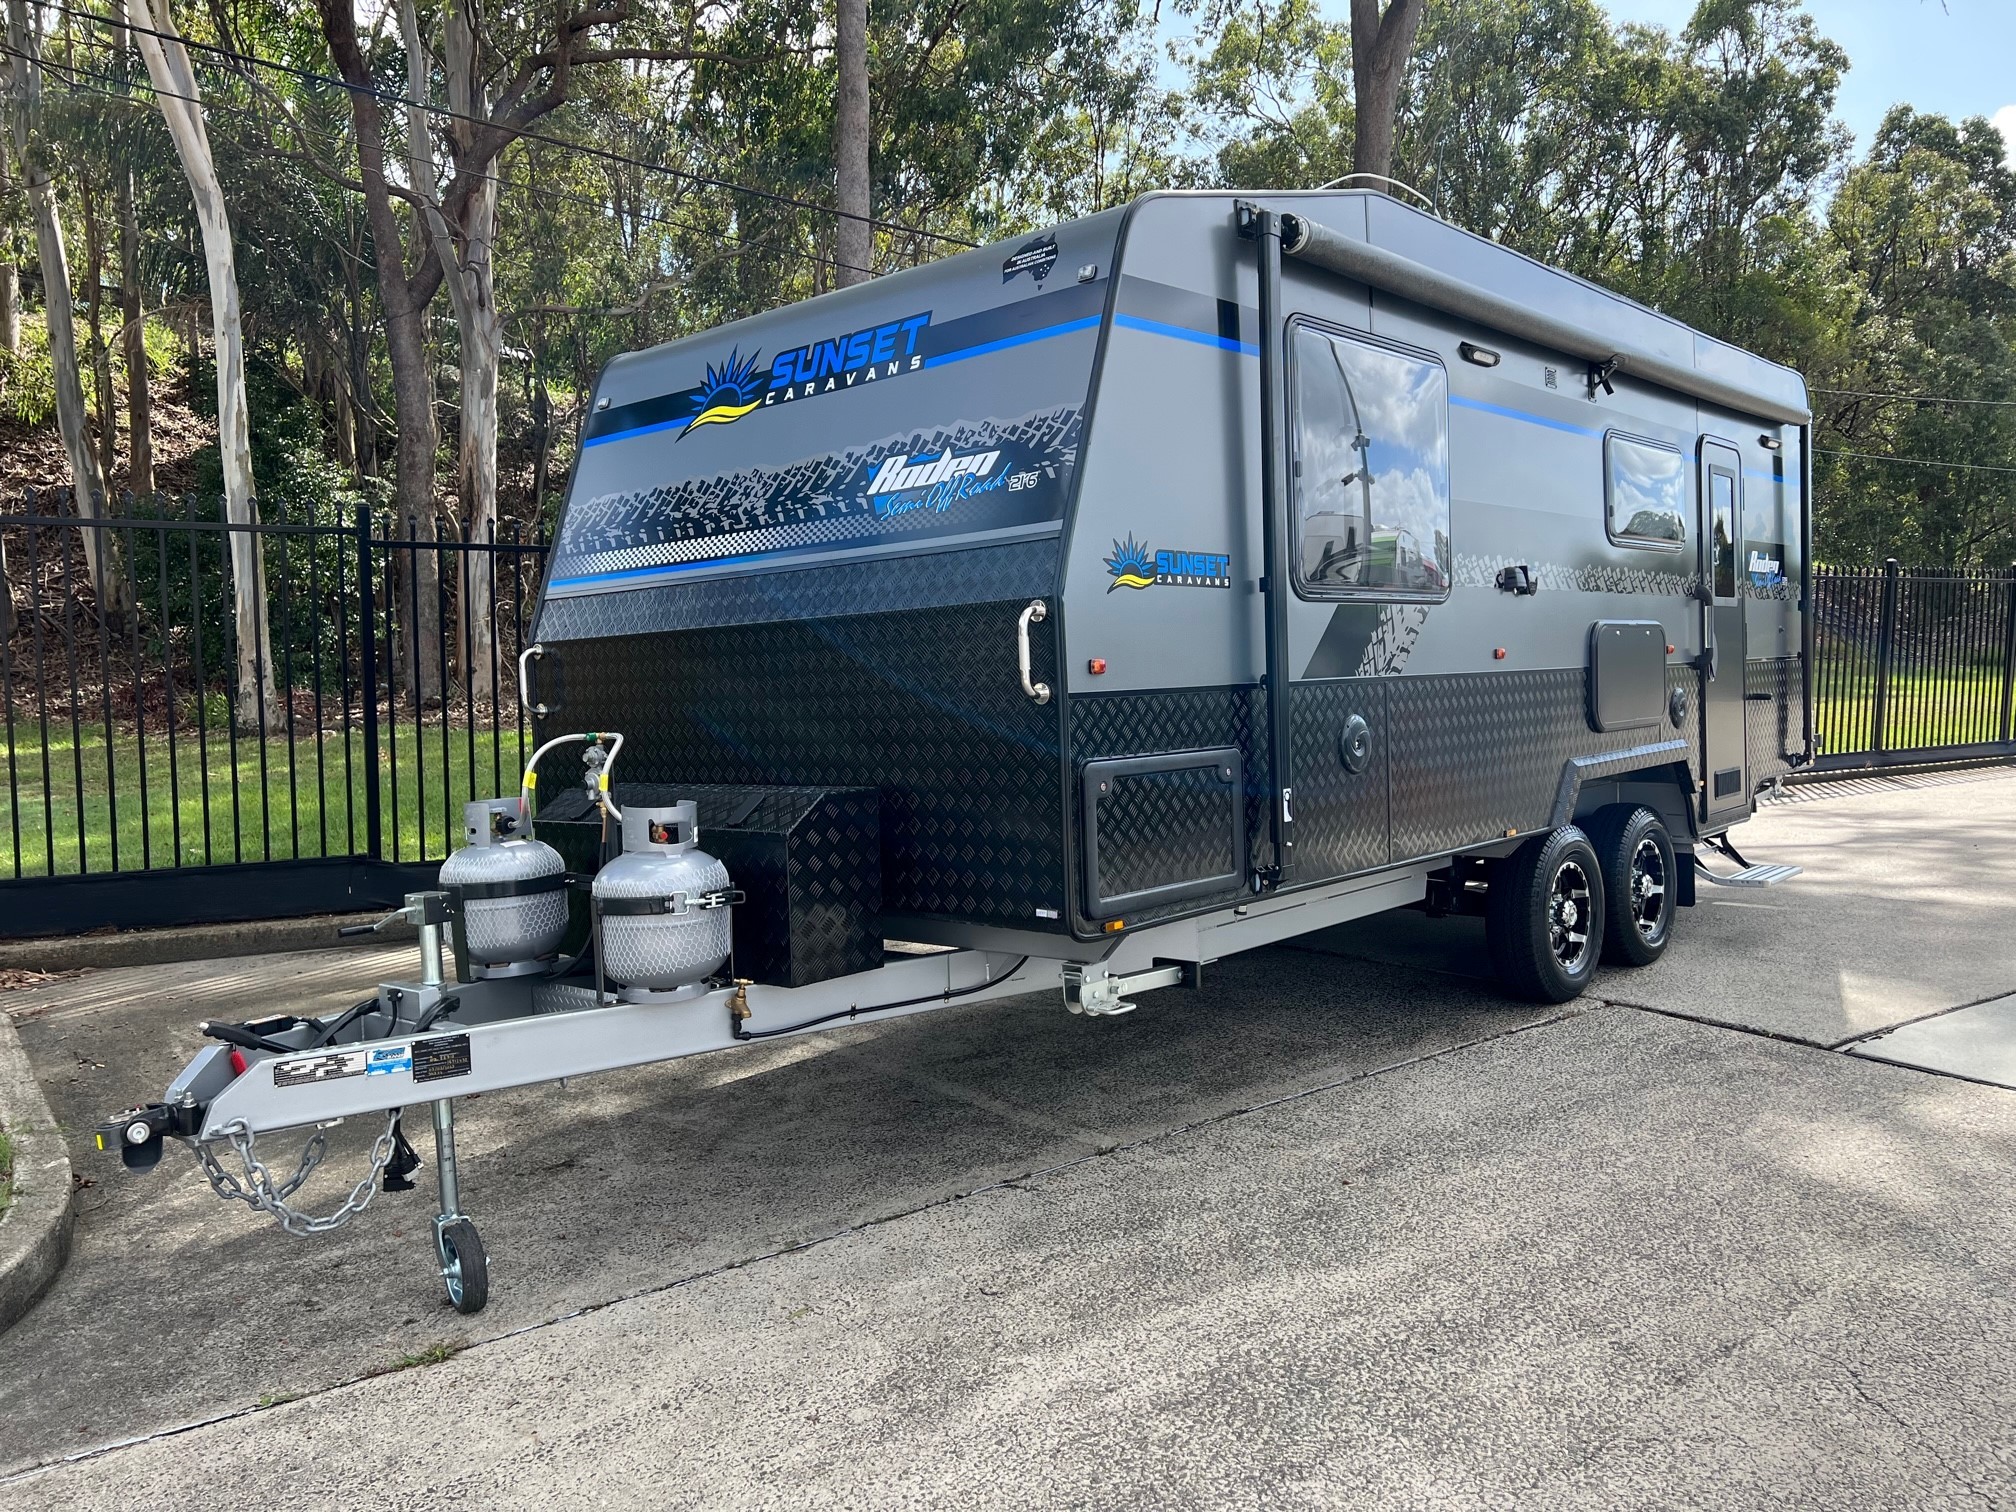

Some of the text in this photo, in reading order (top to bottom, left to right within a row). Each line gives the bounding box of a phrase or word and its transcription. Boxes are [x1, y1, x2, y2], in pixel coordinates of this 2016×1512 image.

[1022, 253, 1046, 263] AUSTRALIA
[1043, 244, 1056, 252] BUILT
[769, 312, 932, 390] SUNSET
[765, 355, 922, 406] CARAVANS
[866, 446, 1001, 495] Rodeo
[881, 461, 1012, 521] Semi Off Road
[1156, 550, 1229, 577] SUNSET
[1749, 551, 1780, 573] Rodeo
[1156, 575, 1229, 587] CARAVANS
